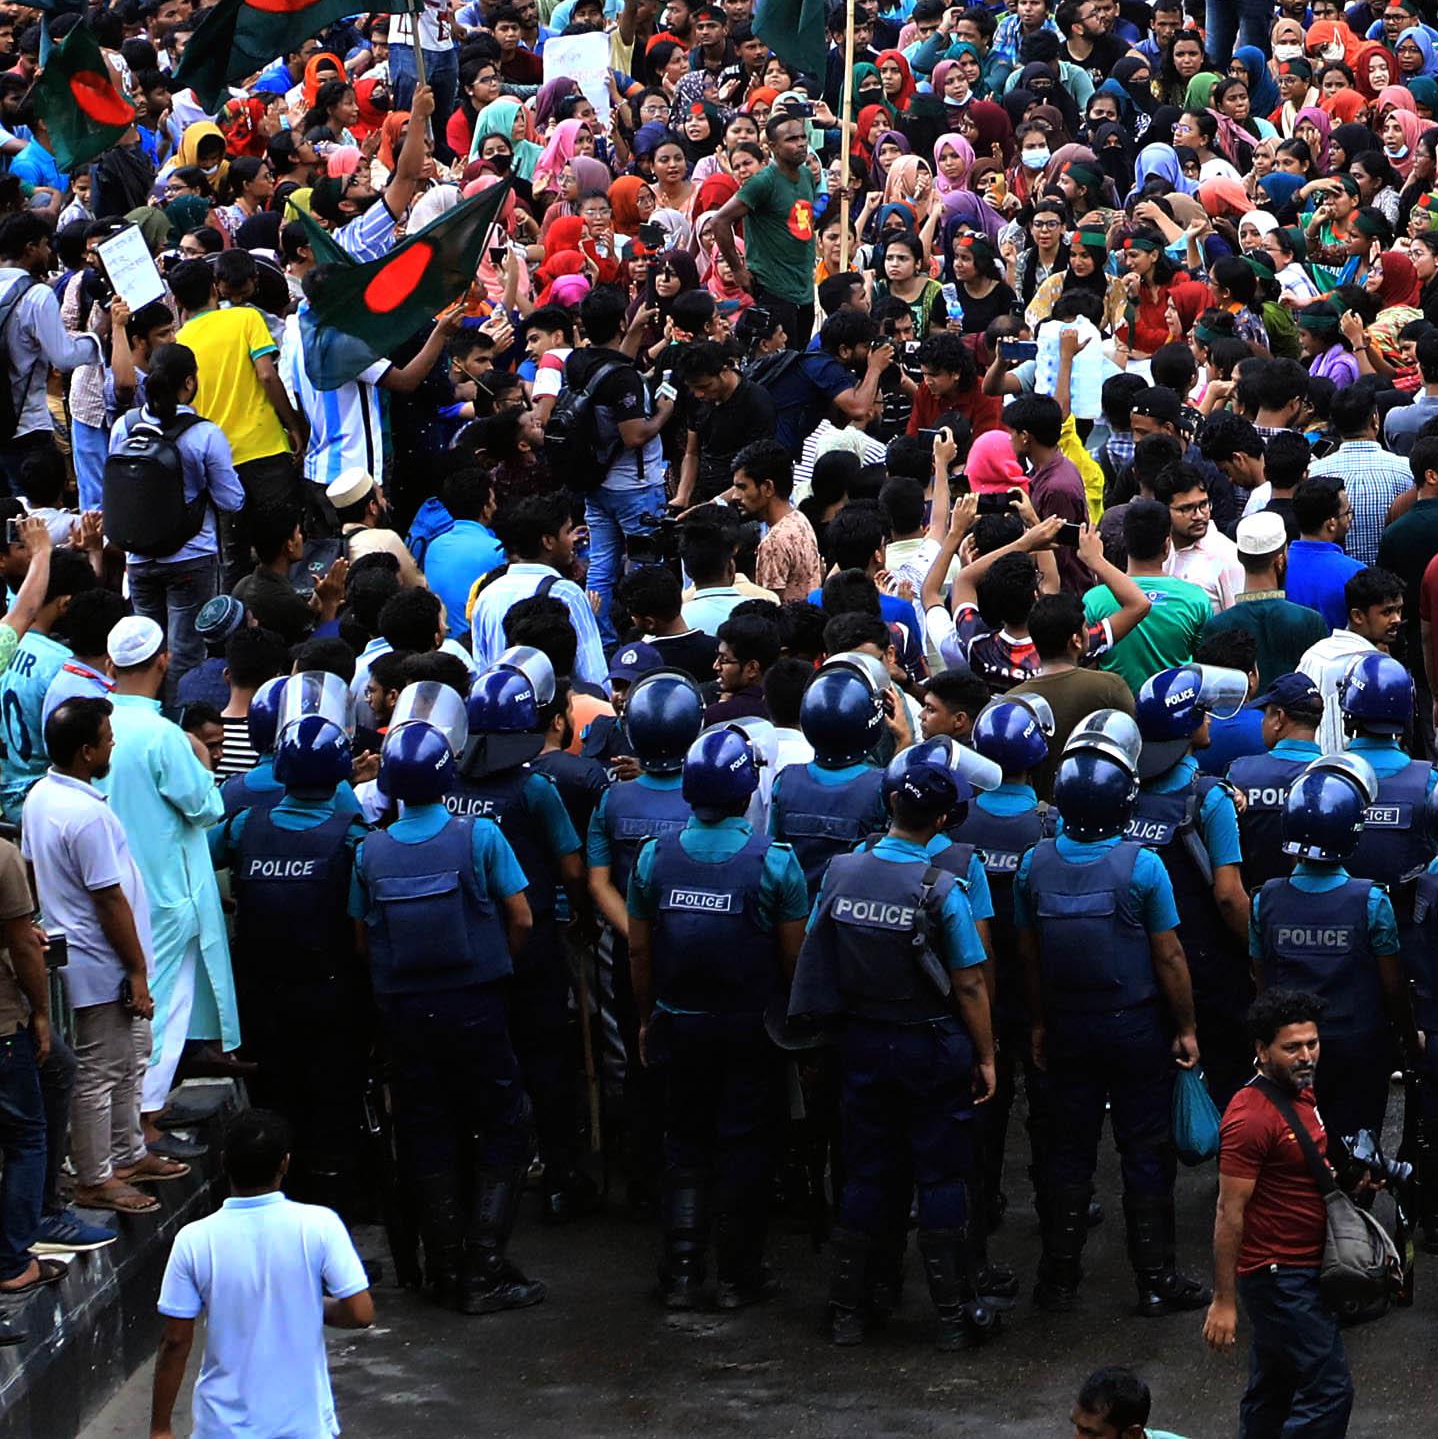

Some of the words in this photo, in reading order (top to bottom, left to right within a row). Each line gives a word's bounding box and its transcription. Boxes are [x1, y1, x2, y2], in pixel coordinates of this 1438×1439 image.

[1164, 688, 1195, 708] POLICE
[441, 794, 495, 816] OLICE
[1124, 819, 1168, 841] OLICE
[250, 859, 315, 877] POLICE
[675, 893, 725, 908] POLICE
[836, 897, 915, 927] POLICE
[1278, 928, 1349, 948] POLICE
